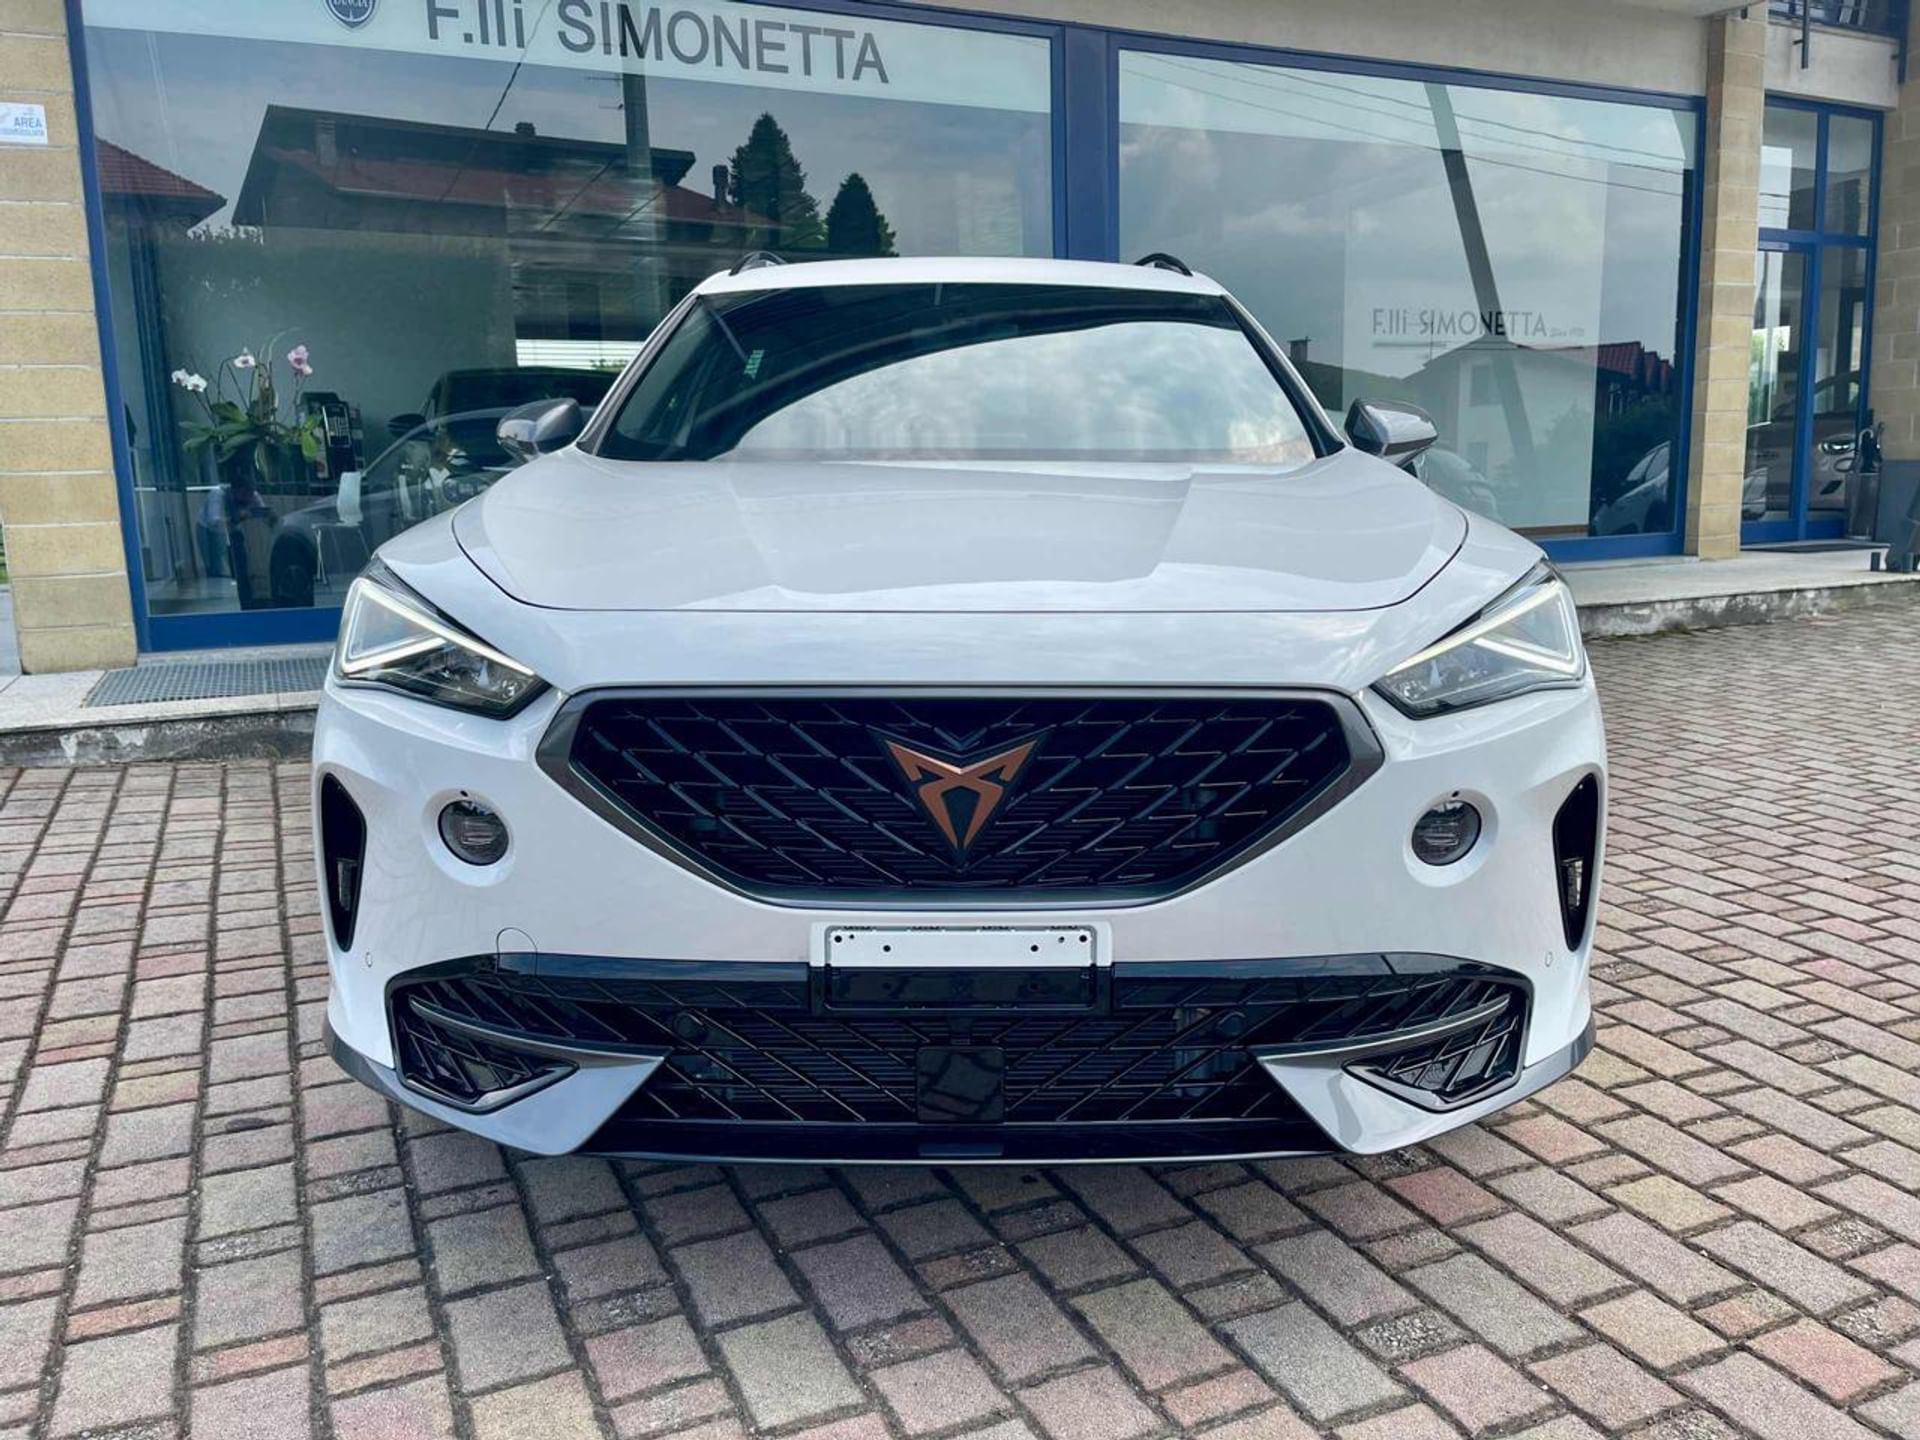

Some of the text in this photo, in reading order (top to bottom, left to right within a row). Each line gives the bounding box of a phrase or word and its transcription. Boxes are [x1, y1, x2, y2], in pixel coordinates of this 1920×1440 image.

[557, 0, 889, 84] SIMONETTA
[14, 116, 43, 128] AREA
[1419, 310, 1548, 337] SIMONETTA
